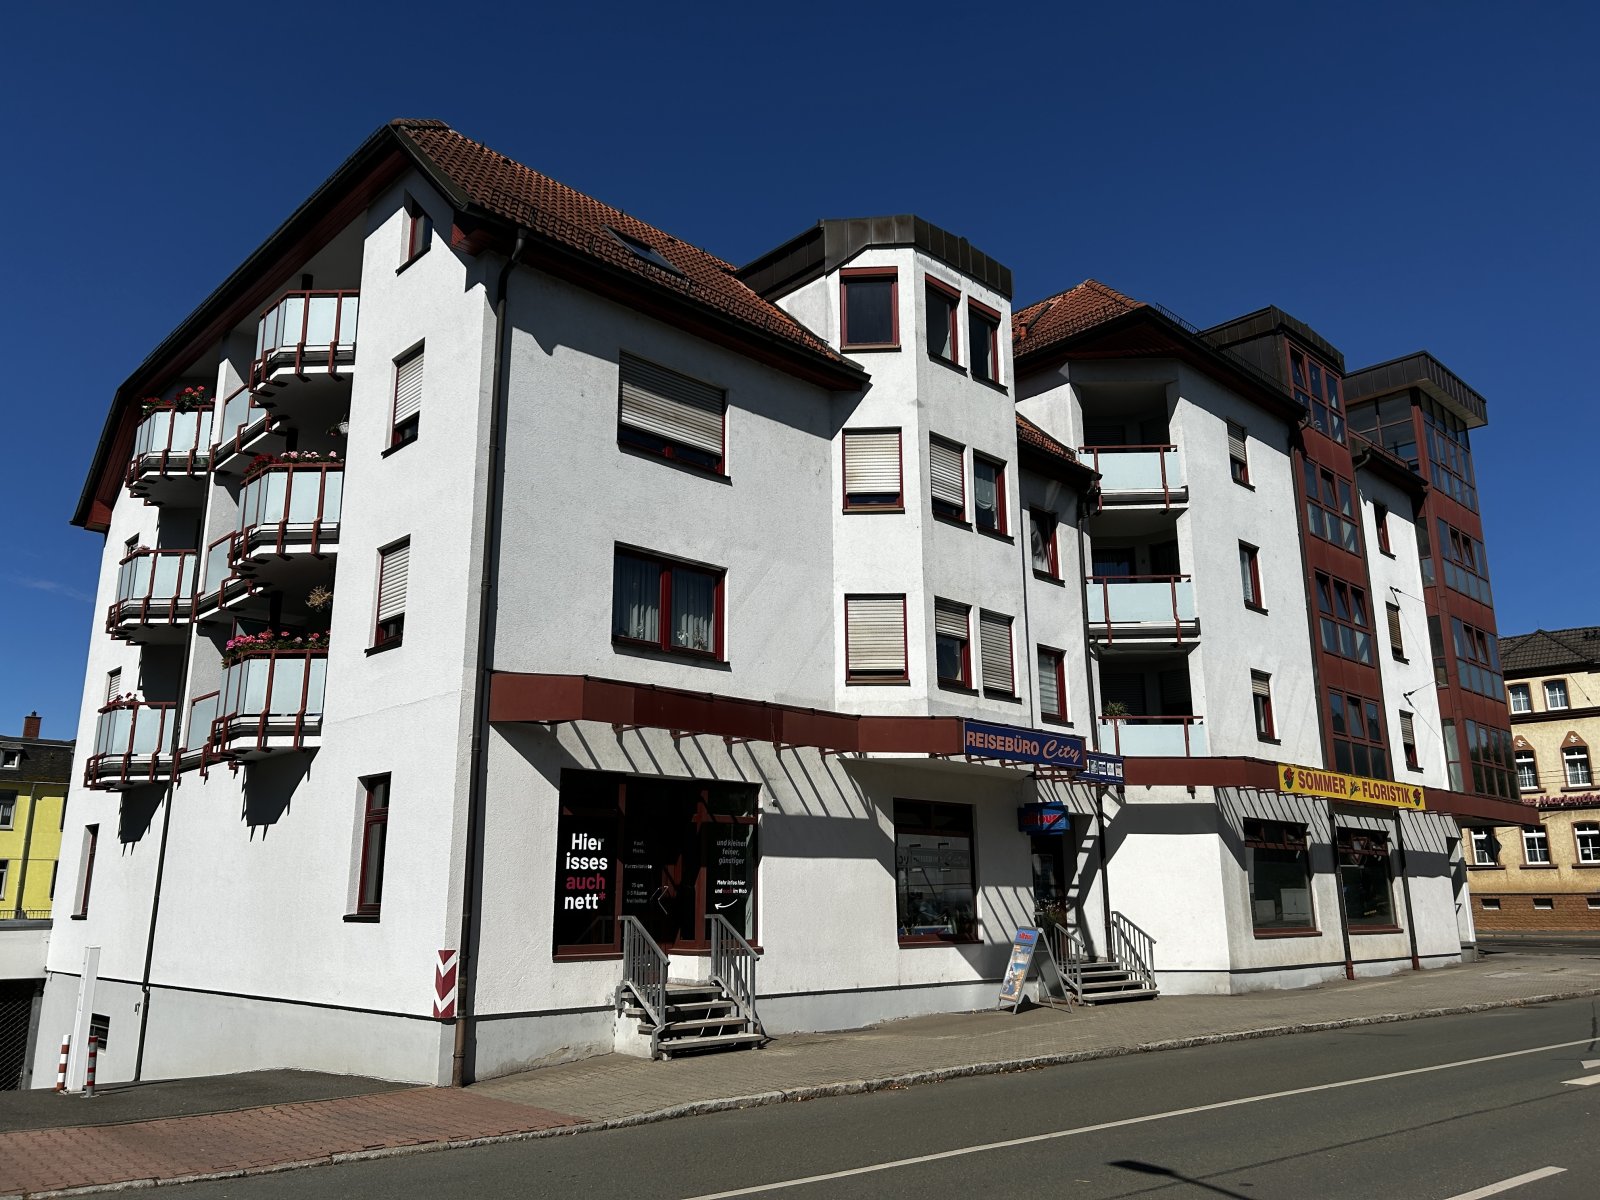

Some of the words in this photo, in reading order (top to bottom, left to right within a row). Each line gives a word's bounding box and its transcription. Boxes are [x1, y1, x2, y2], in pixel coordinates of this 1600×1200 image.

[966, 731, 1040, 756] REISEBÜRO
[1042, 739, 1080, 763] City
[1298, 771, 1347, 795] SOMMER
[1362, 781, 1412, 804] FLORISTIK
[571, 832, 605, 851] Hier
[565, 851, 608, 870] isses
[718, 856, 745, 866] günstiger
[566, 873, 606, 890] auch
